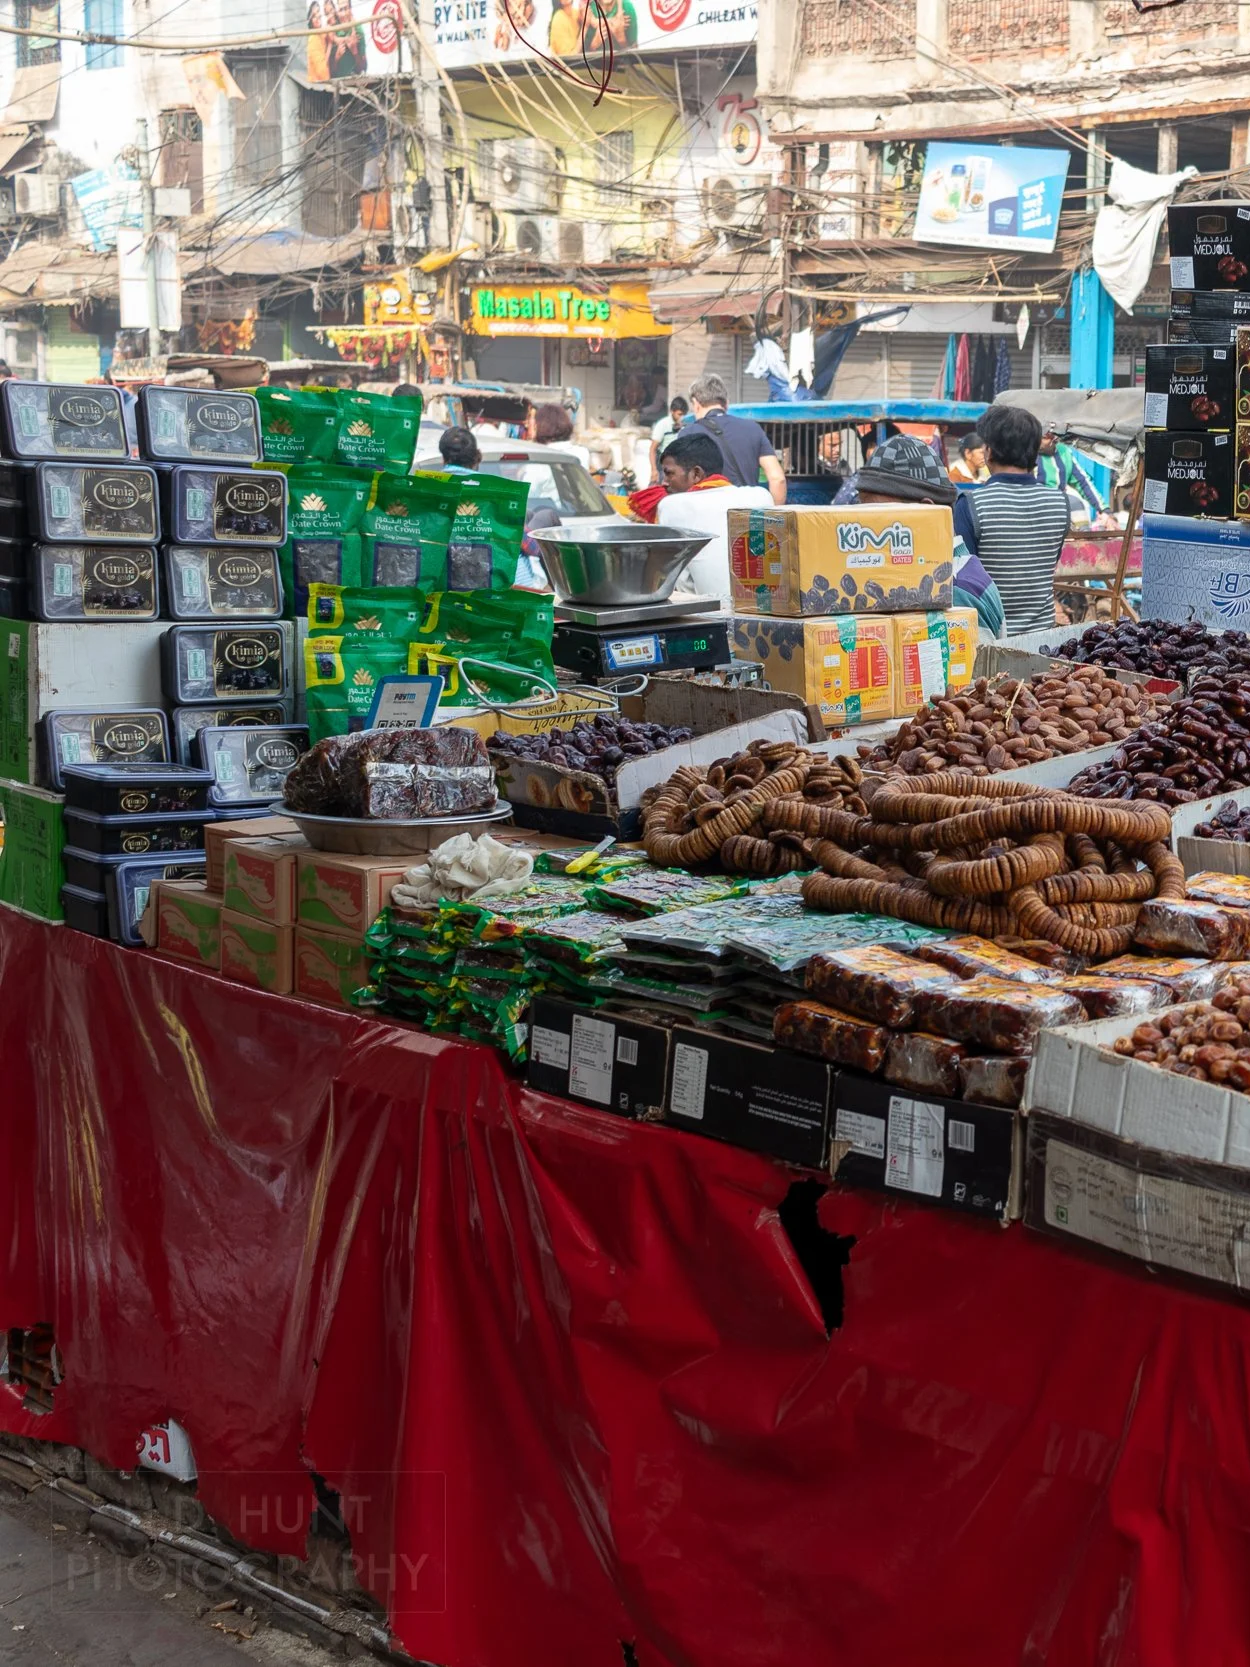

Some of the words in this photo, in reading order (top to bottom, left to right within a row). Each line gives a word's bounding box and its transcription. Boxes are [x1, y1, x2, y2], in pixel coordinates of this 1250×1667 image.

[698, 7, 747, 26] CHILEAN
[1193, 244, 1233, 255] MEDJOUL
[477, 289, 555, 320] Masala
[557, 291, 611, 321] Tree
[1169, 384, 1207, 395] MEDJOUL
[66, 402, 100, 420] kimia
[203, 408, 237, 425] kimia
[277, 443, 305, 451] Crown
[338, 442, 357, 451] Date
[358, 445, 386, 454] Crown
[1167, 469, 1206, 480] MEDJOUL
[100, 484, 135, 502] kimia
[233, 488, 265, 507] kimia
[291, 520, 309, 528] Date
[310, 520, 342, 528] Crown
[374, 523, 393, 532] Date
[394, 526, 421, 534] Crown
[452, 525, 466, 533] ate
[466, 524, 493, 533] Crown
[839, 524, 912, 550] Kimia
[893, 556, 912, 564] DATES
[101, 562, 135, 581] kimia
[224, 562, 257, 580] kimia
[231, 645, 264, 662] kimia
[111, 729, 145, 750] kimia
[261, 743, 296, 762] kimia
